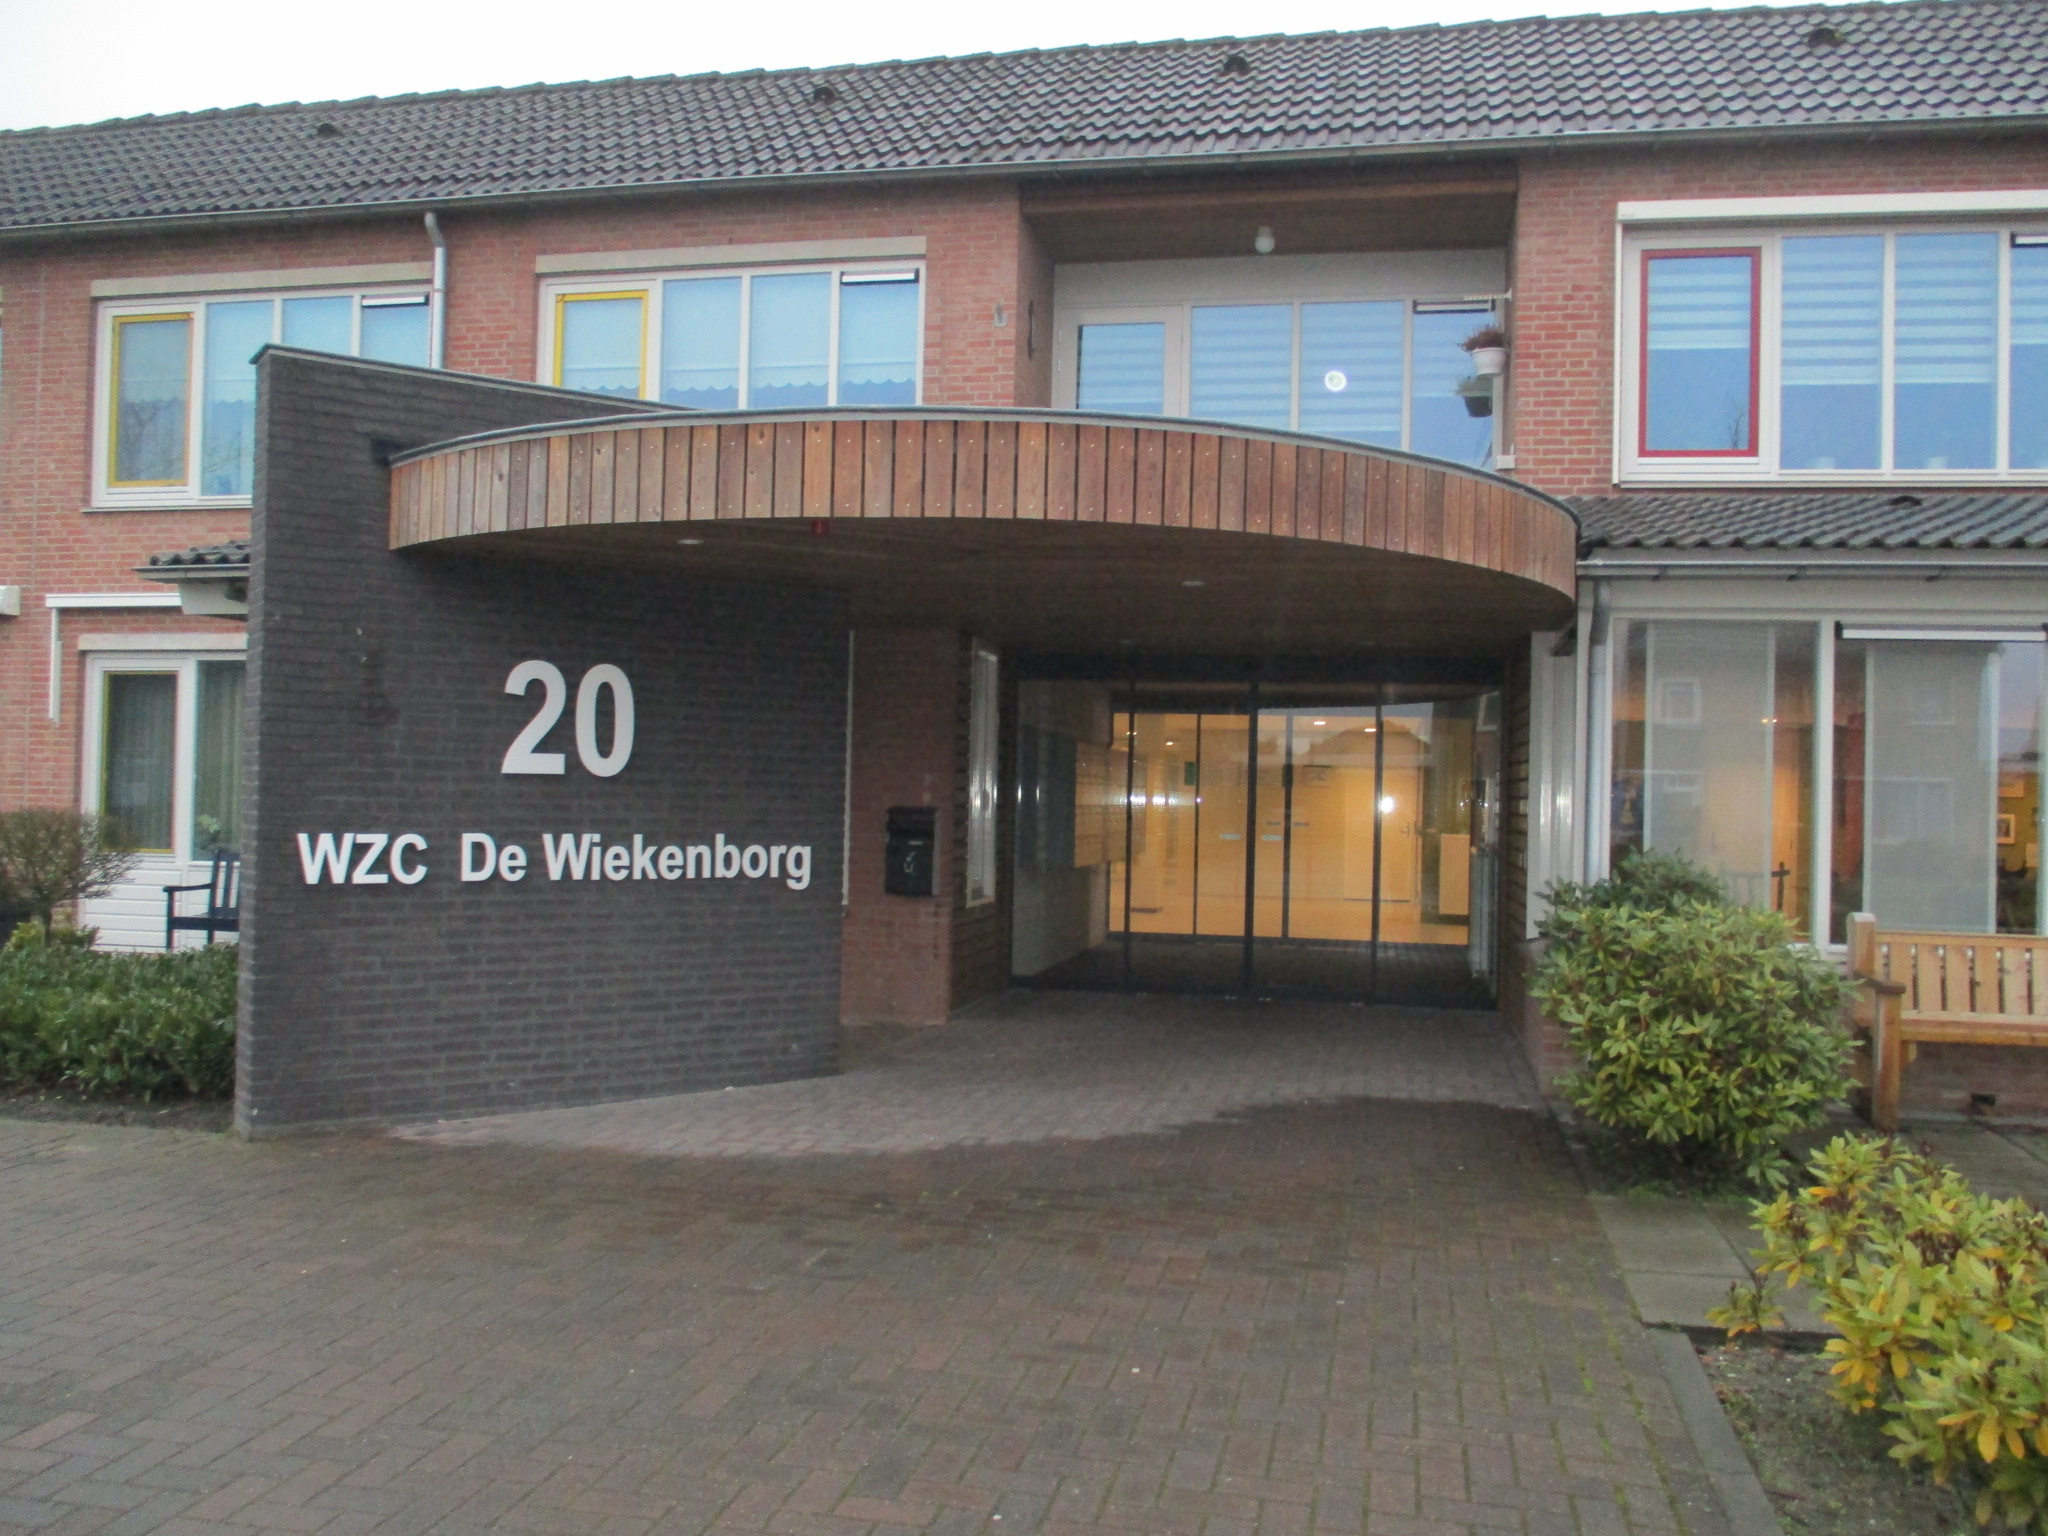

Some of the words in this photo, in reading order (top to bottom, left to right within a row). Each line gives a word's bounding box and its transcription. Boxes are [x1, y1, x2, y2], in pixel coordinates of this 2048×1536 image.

[501, 660, 635, 777] 20
[298, 833, 428, 885] WZC
[460, 833, 527, 882] De
[543, 833, 812, 890] Wiekenborg
